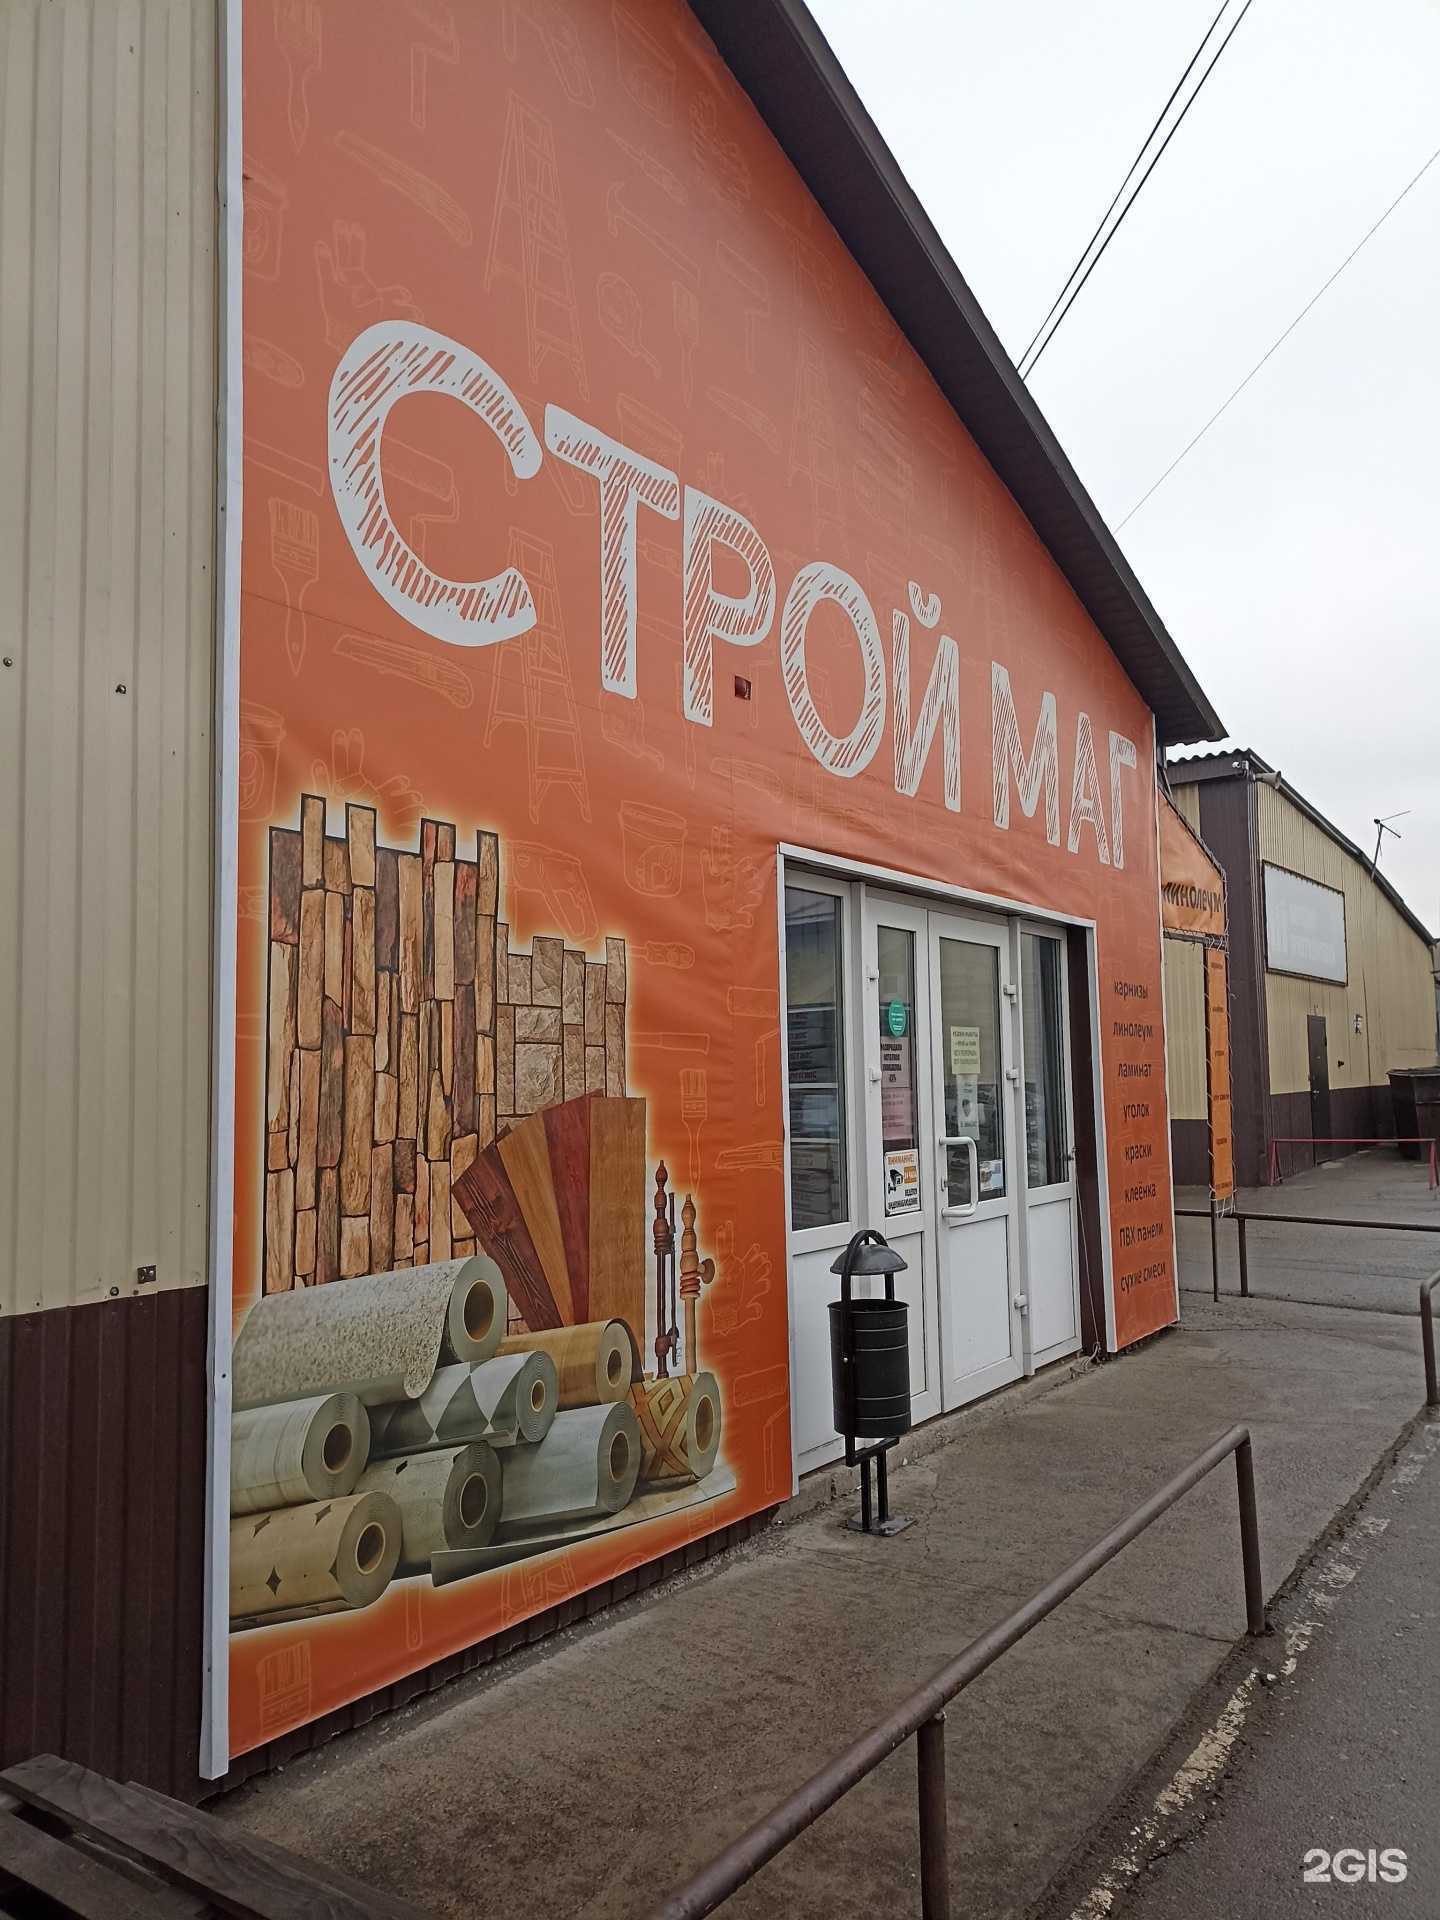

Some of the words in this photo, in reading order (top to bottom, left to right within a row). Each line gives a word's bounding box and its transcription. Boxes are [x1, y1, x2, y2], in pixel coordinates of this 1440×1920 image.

[327, 319, 961, 813] СТРОЙ
[991, 661, 1136, 870] МАГ
[1114, 980, 1148, 1000] карнизы
[1113, 1021, 1153, 1041] линолеум
[1118, 1063, 1152, 1078] ламинат
[1123, 1102, 1150, 1122] уголок
[1125, 1143, 1152, 1165] краски
[1124, 1180, 1157, 1204] клеёнка
[1119, 1228, 1135, 1248] ПВХ
[1137, 1222, 1164, 1242] панели
[1120, 1272, 1142, 1294] сухие
[1143, 1261, 1167, 1282] смеси
